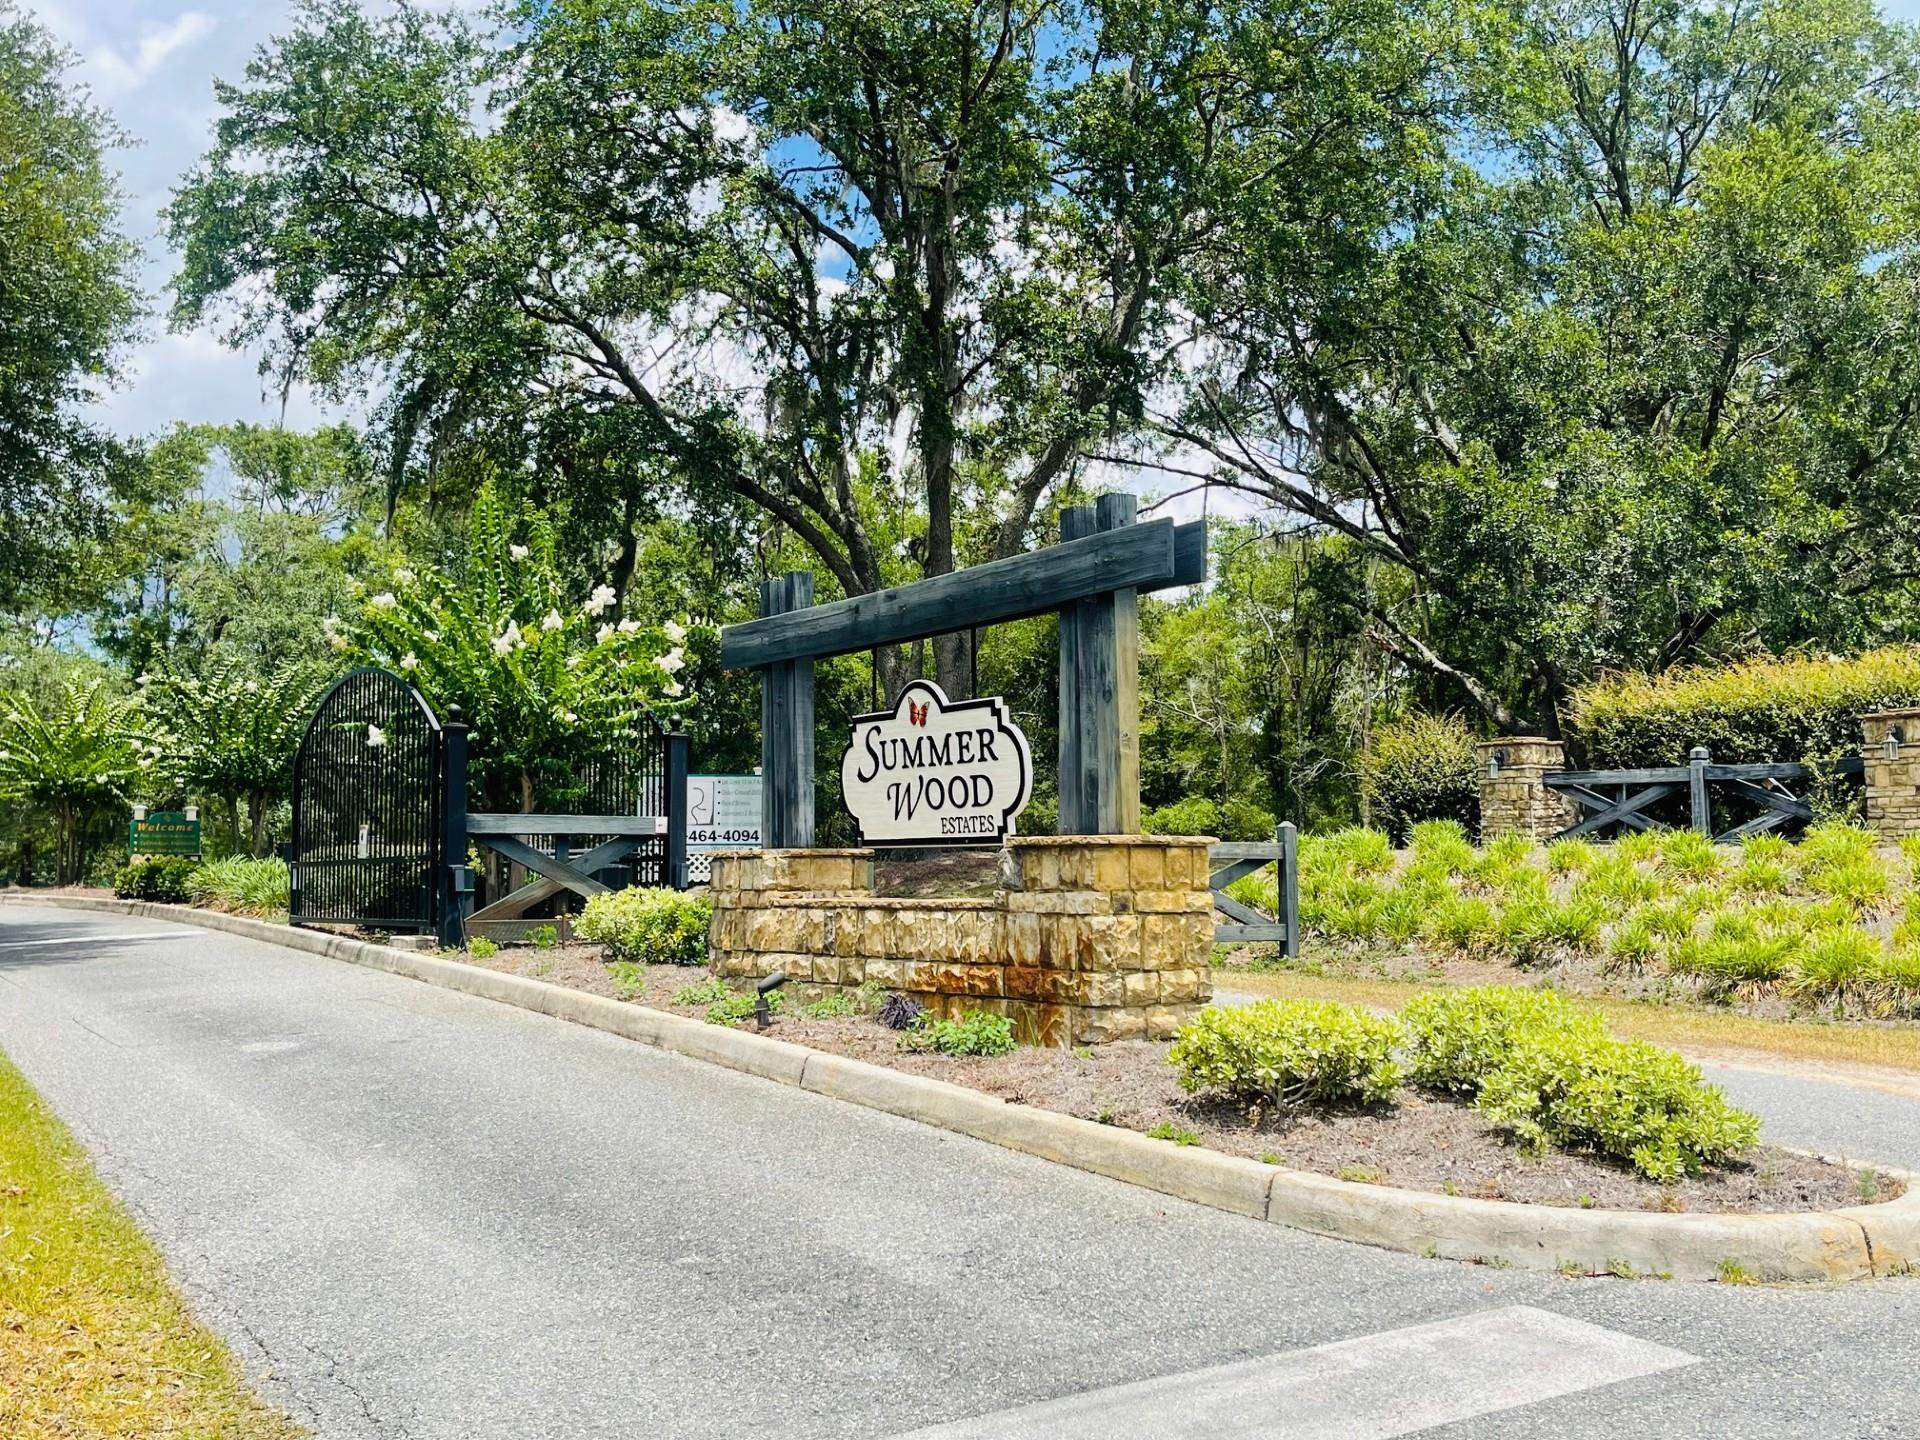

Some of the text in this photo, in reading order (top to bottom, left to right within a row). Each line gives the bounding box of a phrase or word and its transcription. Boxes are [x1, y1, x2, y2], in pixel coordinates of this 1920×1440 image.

[857, 725, 999, 783] SUMMER
[887, 774, 994, 821] WOOD
[137, 822, 193, 832] Welcome
[941, 814, 995, 835] ESTATES
